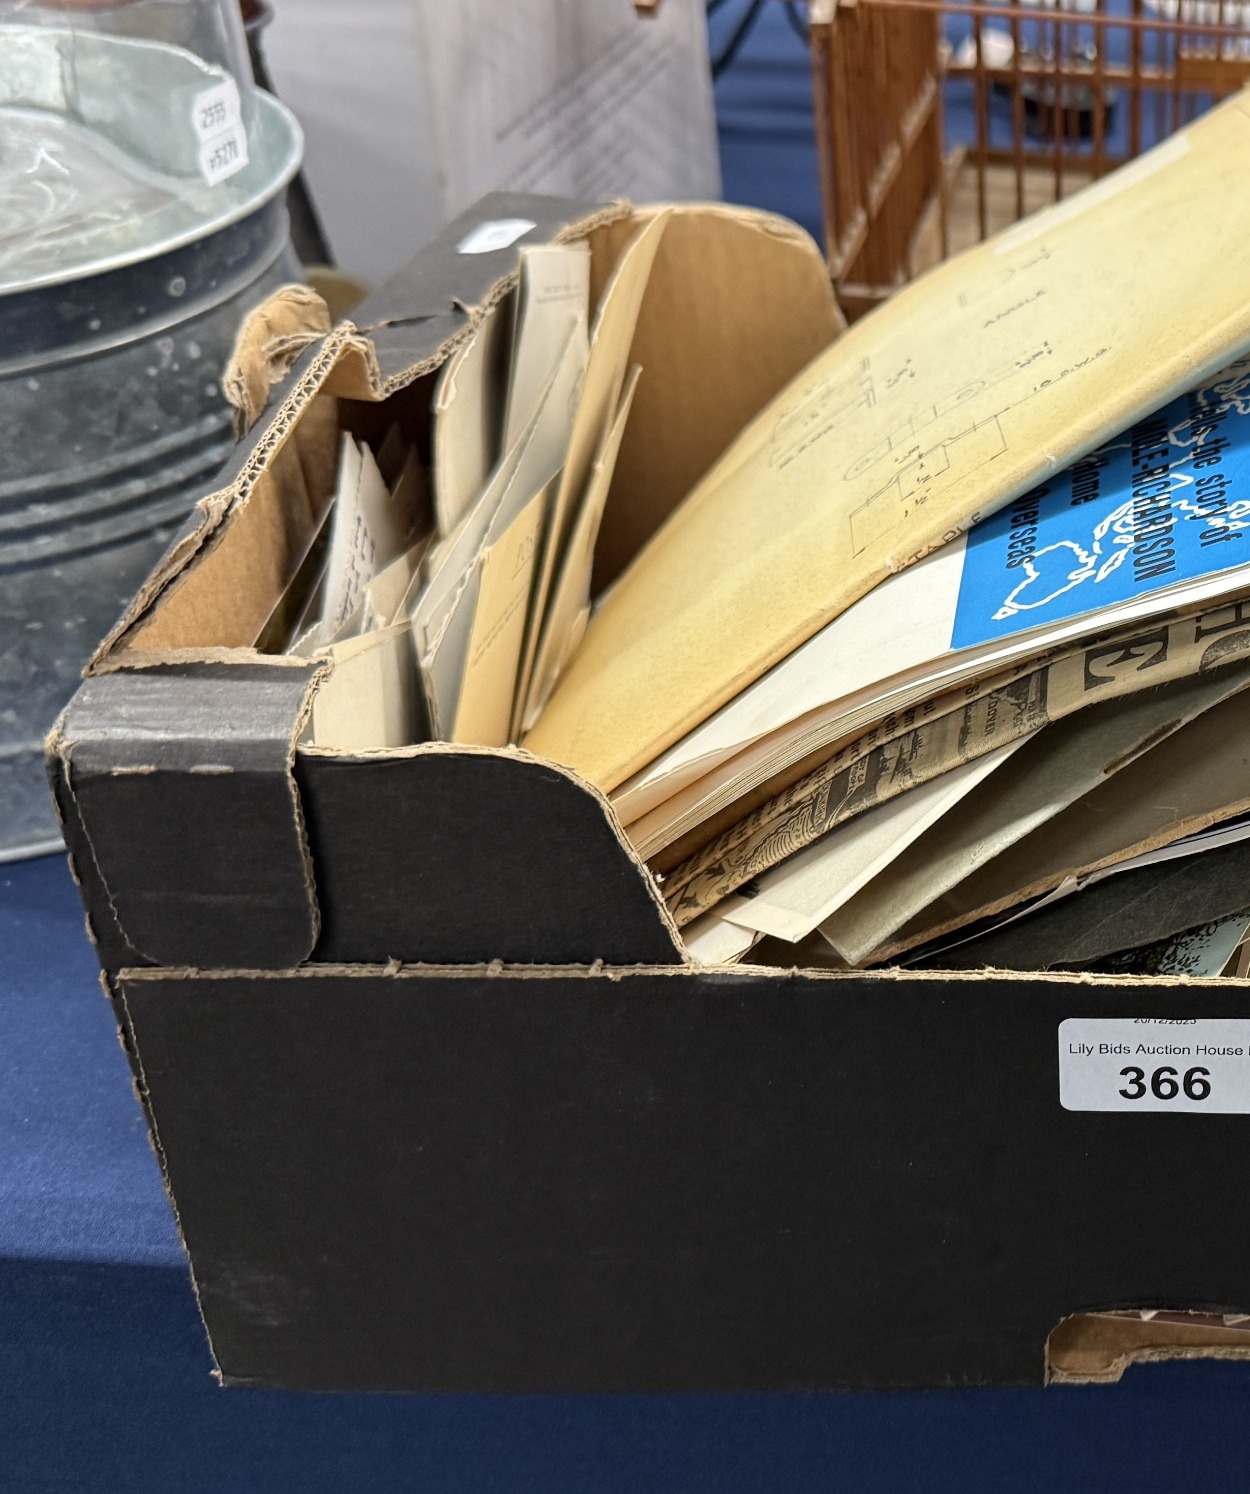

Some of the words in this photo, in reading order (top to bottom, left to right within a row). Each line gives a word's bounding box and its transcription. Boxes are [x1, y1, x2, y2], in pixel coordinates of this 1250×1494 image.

[1192, 436, 1231, 470] the
[1070, 457, 1109, 507] Home
[1131, 417, 1176, 583] MOLE-RICHARDSON
[1189, 473, 1233, 521] story
[1005, 487, 1051, 570] Overseas
[1199, 525, 1243, 548] of
[984, 700, 998, 738] DOVER
[1069, 1043, 1095, 1057] Lily
[1099, 1043, 1131, 1055] Bids
[1136, 1043, 1191, 1055] Auction
[1196, 1045, 1244, 1056] House
[1118, 1066, 1212, 1101] 366
